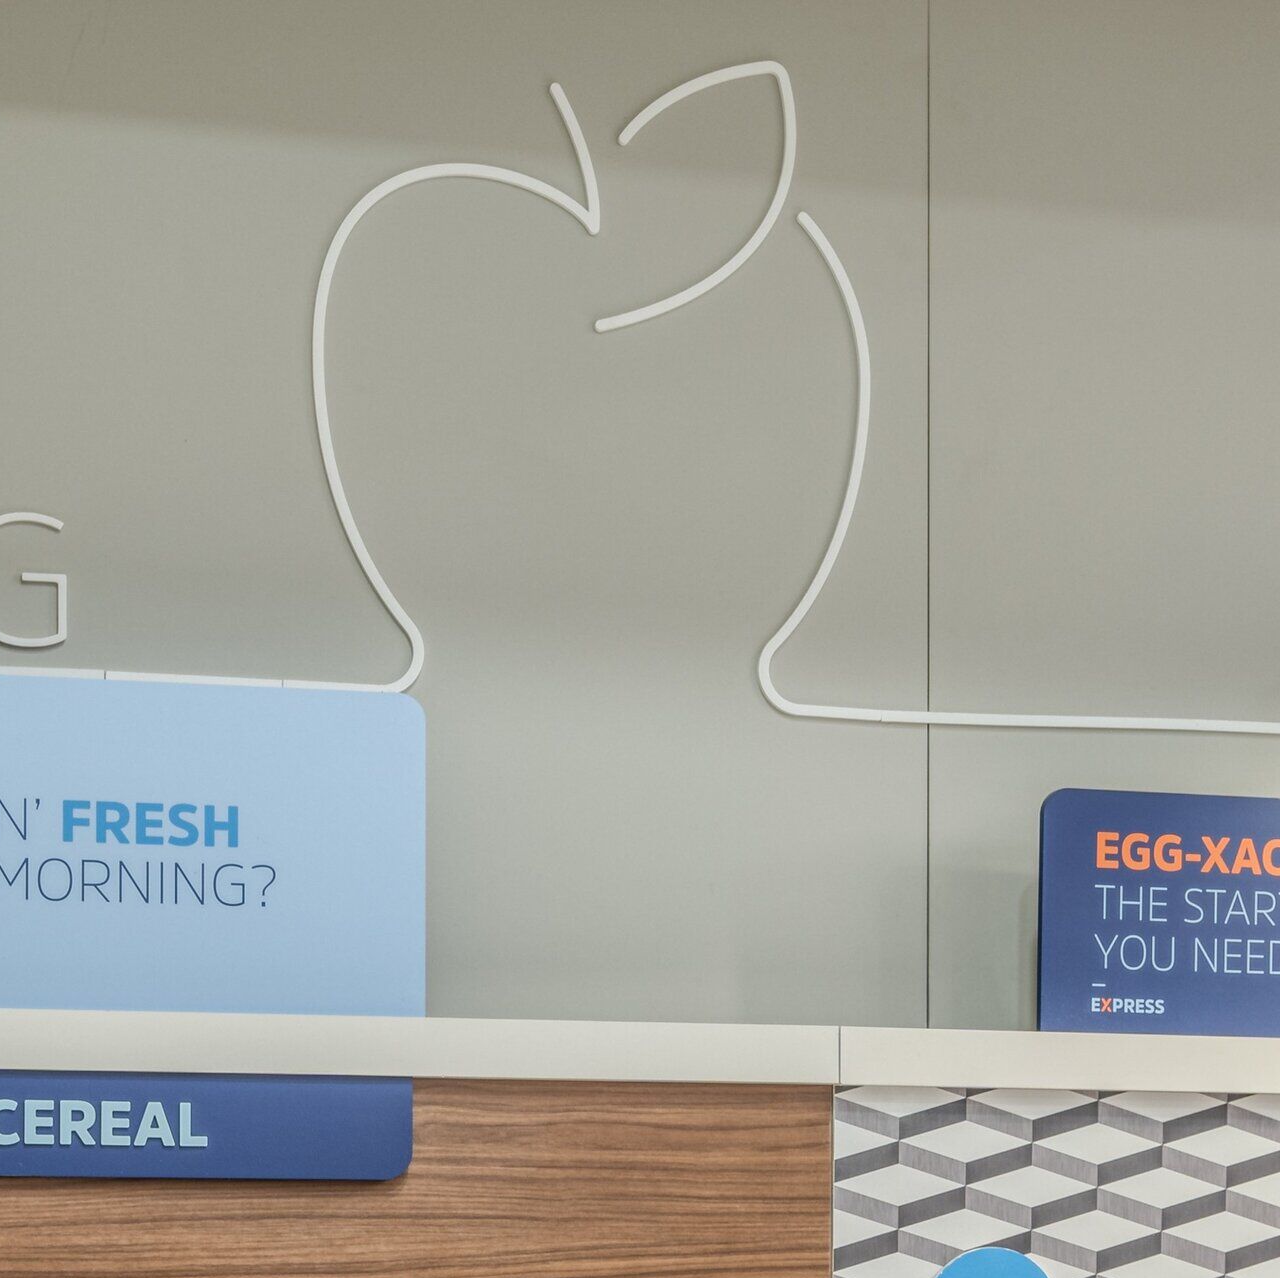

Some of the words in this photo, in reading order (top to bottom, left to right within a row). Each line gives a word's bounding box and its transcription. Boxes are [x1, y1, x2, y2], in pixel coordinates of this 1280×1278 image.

[61, 799, 239, 848] FRESH
[1094, 884, 1168, 923] THE
[1094, 932, 1175, 972] YOU
[1091, 996, 1165, 1015] EXPRESS
